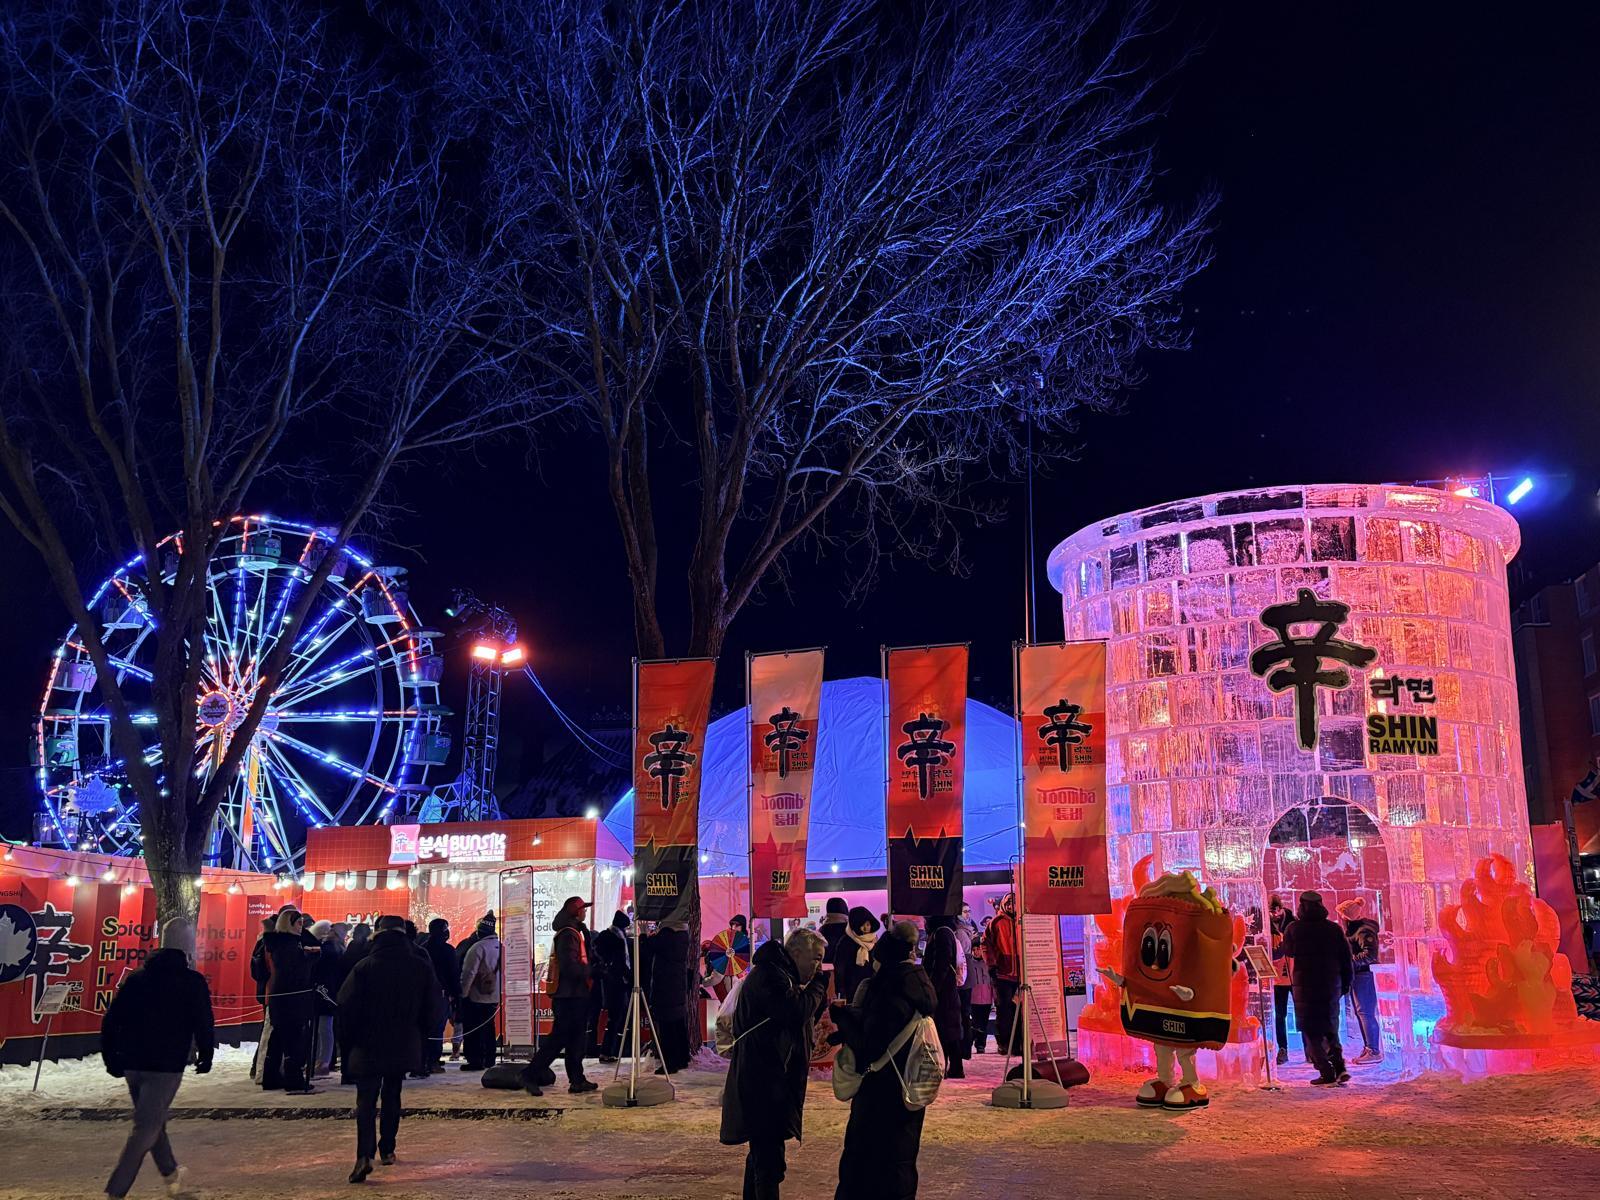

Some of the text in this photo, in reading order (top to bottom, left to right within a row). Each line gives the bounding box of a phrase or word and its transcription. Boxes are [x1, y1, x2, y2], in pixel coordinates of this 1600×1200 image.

[1251, 588, 1378, 752] 辛
[1369, 674, 1437, 706] 라면
[1038, 699, 1093, 773] 辛
[1368, 715, 1438, 741] SHIN
[764, 706, 811, 781] 辛
[1369, 739, 1438, 755] RAMYUN
[792, 760, 808, 768] SHIN
[897, 713, 957, 801] 辛
[643, 724, 697, 811] 辛
[932, 780, 953, 788] SHIN
[1036, 787, 1097, 805] Toomba
[418, 833, 449, 859] 분식
[646, 872, 676, 887] SHIN
[910, 865, 945, 880] SHIN
[1048, 866, 1084, 880] SHIN
[647, 885, 678, 896] RAMYUN
[910, 878, 945, 889] RAMYUN
[1049, 879, 1084, 888] RAMYUN
[101, 916, 152, 941] Spicy
[1163, 1019, 1186, 1034] SHIN
